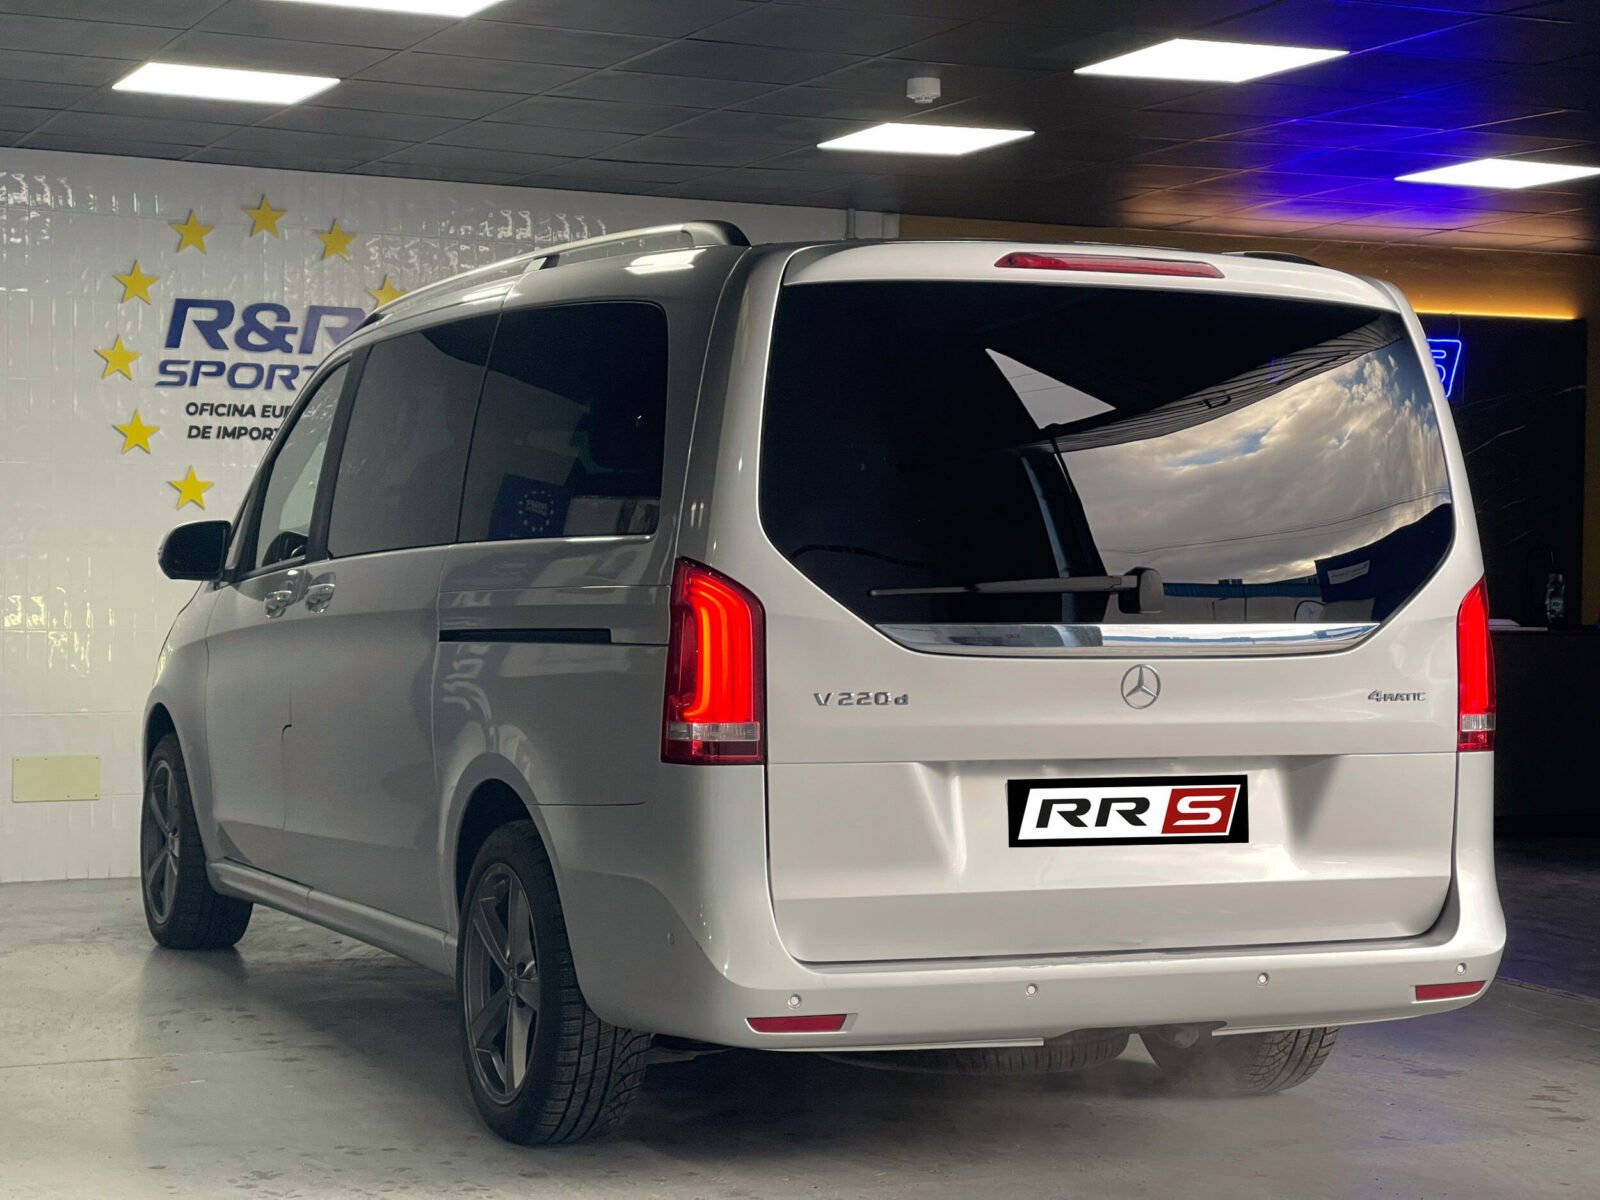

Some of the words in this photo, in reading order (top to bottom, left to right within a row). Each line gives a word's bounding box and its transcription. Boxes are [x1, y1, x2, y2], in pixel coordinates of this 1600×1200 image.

[165, 298, 366, 354] R&R
[155, 360, 317, 390] SPOR
[185, 402, 256, 418] OFICINA
[187, 425, 212, 439] DE
[1367, 689, 1427, 702] 4MATIC
